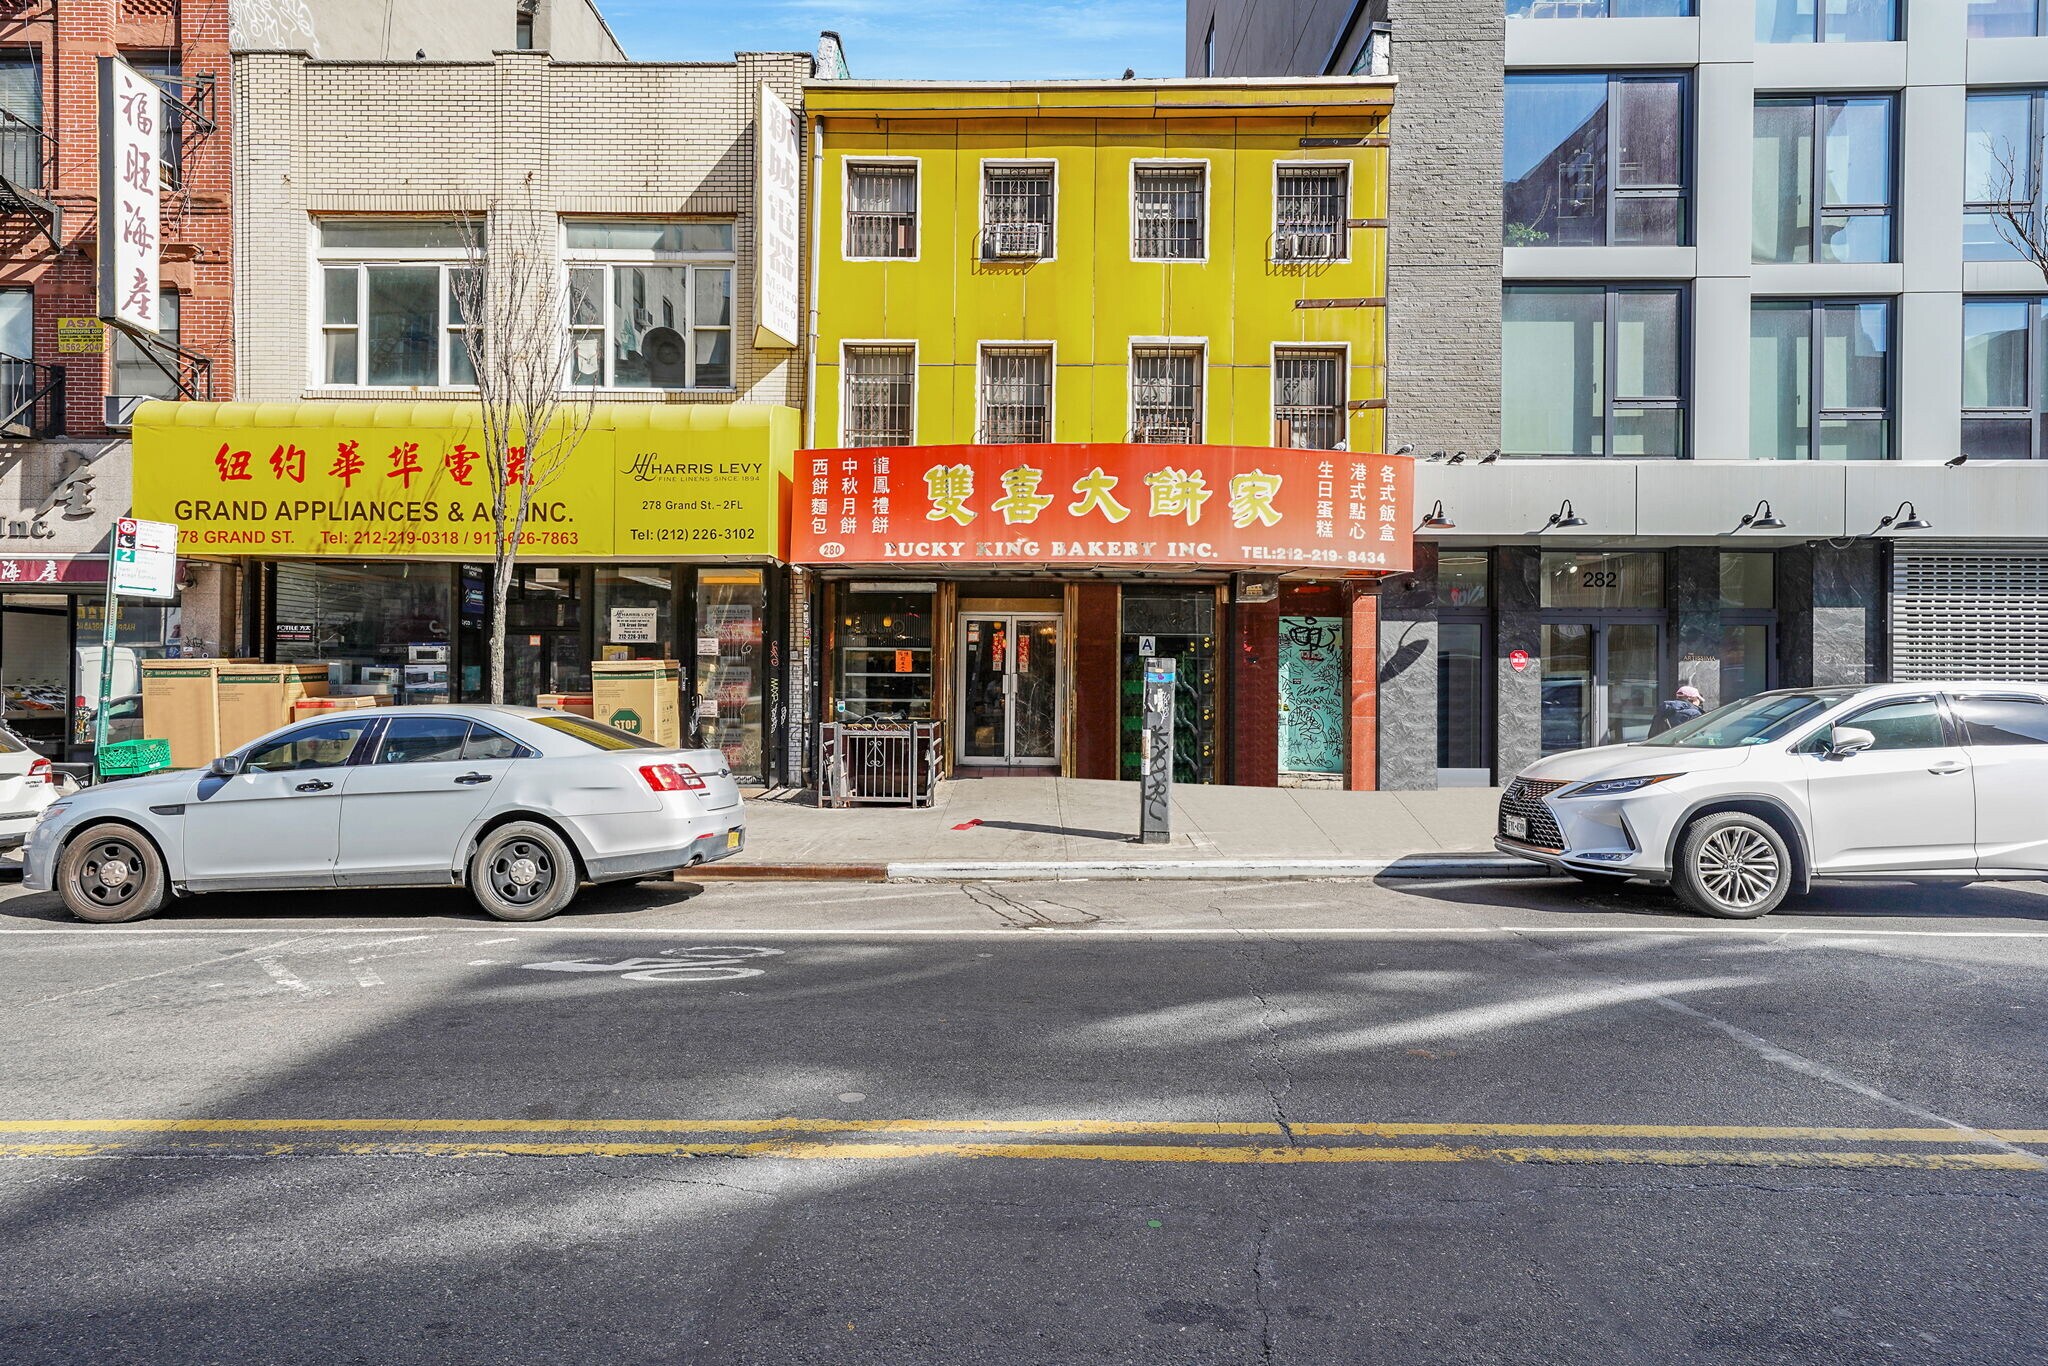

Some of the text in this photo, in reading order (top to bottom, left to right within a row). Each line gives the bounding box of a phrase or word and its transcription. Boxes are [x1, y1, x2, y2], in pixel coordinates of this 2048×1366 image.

[766, 272, 797, 304] Metro
[768, 291, 796, 320] Video
[66, 319, 97, 328] ASA
[652, 464, 763, 474] HARRIS LEVY
[811, 458, 829, 534] 西餅麵包
[840, 458, 858, 534] 中秋月餅
[922, 463, 1283, 528] 雙喜大餅家
[1316, 461, 1334, 538] 生日蛋糕
[1349, 463, 1367, 540] 港式點心
[1379, 465, 1396, 542] 各式飯盒
[174, 500, 268, 521] GRAND
[274, 500, 438, 522] APPLIANCES
[448, 502, 465, 522] &
[524, 502, 573, 522] INC.
[642, 500, 662, 510] 278
[666, 500, 696, 510] Grand
[176, 531, 198, 544] 78
[204, 531, 266, 544] GRAND
[271, 531, 294, 544] ST.
[320, 531, 348, 544] Tel:
[354, 532, 458, 545] 212-219-0318
[630, 528, 755, 542] Tel: (212) 226-3102
[120, 550, 131, 562] 2
[823, 544, 840, 556] 280
[884, 541, 1218, 558] LUCKY KING BAKERY INC.
[1582, 572, 1617, 588] 282
[1142, 638, 1153, 650] A
[614, 720, 637, 729] STOP
